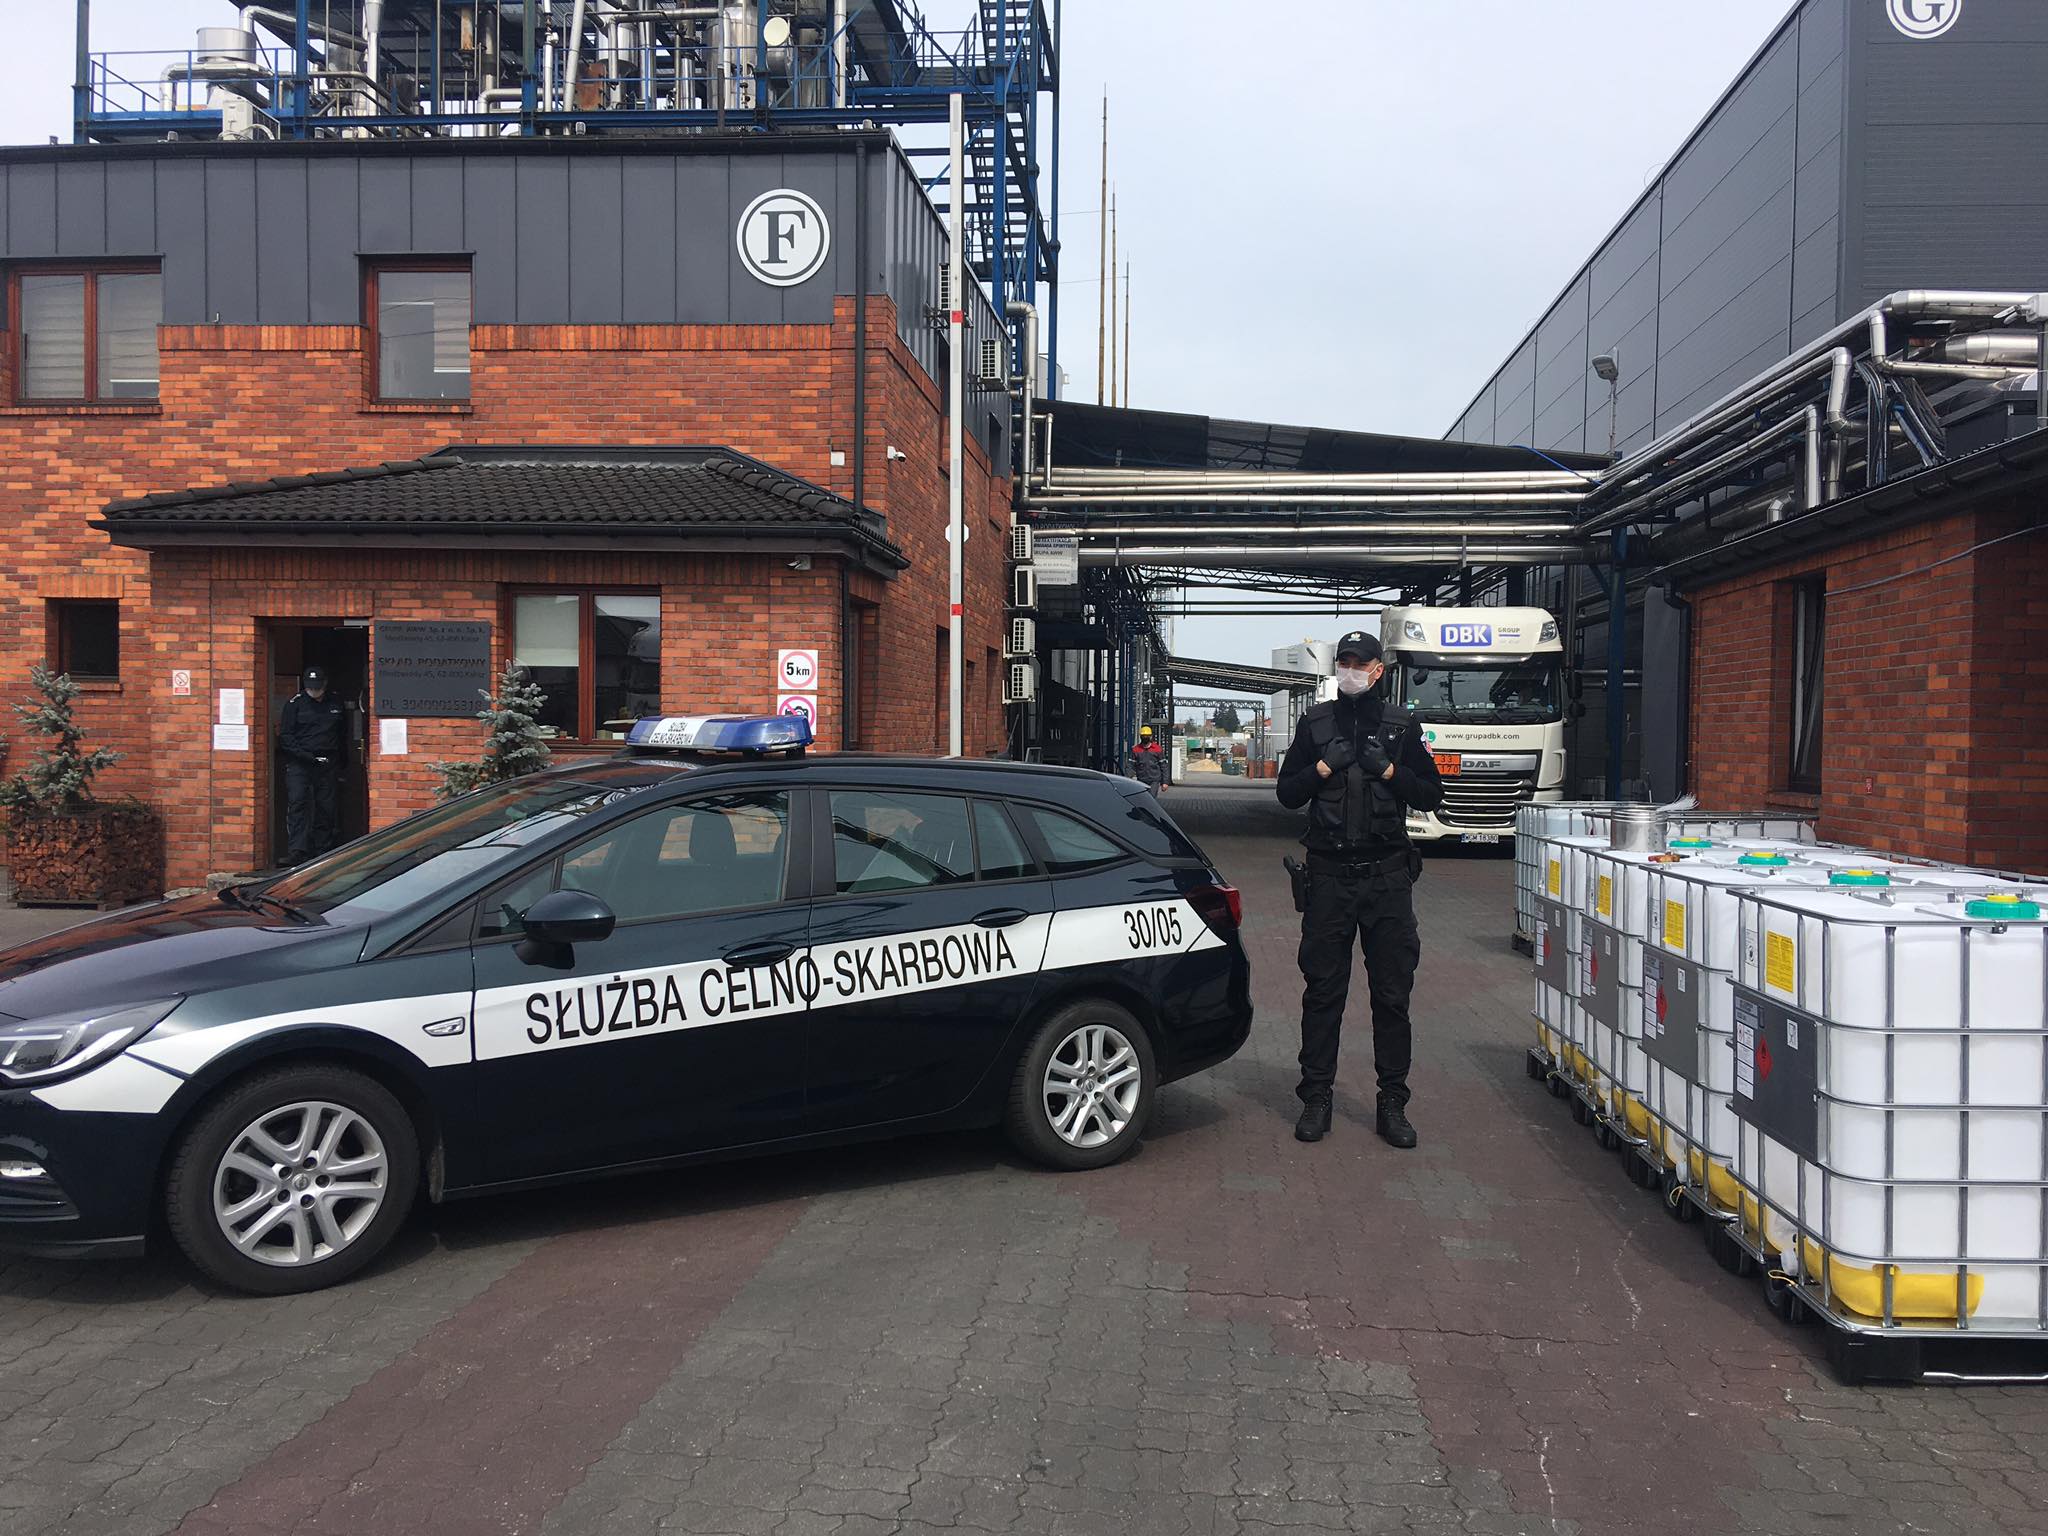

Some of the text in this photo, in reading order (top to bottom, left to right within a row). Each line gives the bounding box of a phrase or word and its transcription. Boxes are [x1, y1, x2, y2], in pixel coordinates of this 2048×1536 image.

[760, 210, 805, 264] F
[1445, 625, 1488, 643] DBK
[418, 658, 486, 667] PODATKOWY
[786, 662, 810, 676] 5 km
[381, 699, 396, 710] PL
[1445, 733, 1520, 741] www.grupadbk.com
[1440, 755, 1453, 763] 33
[1462, 760, 1501, 768] DAF
[1123, 906, 1183, 950] 30/05
[525, 929, 1017, 1045] SŁUŻBA CELNO-SKARBOWA
